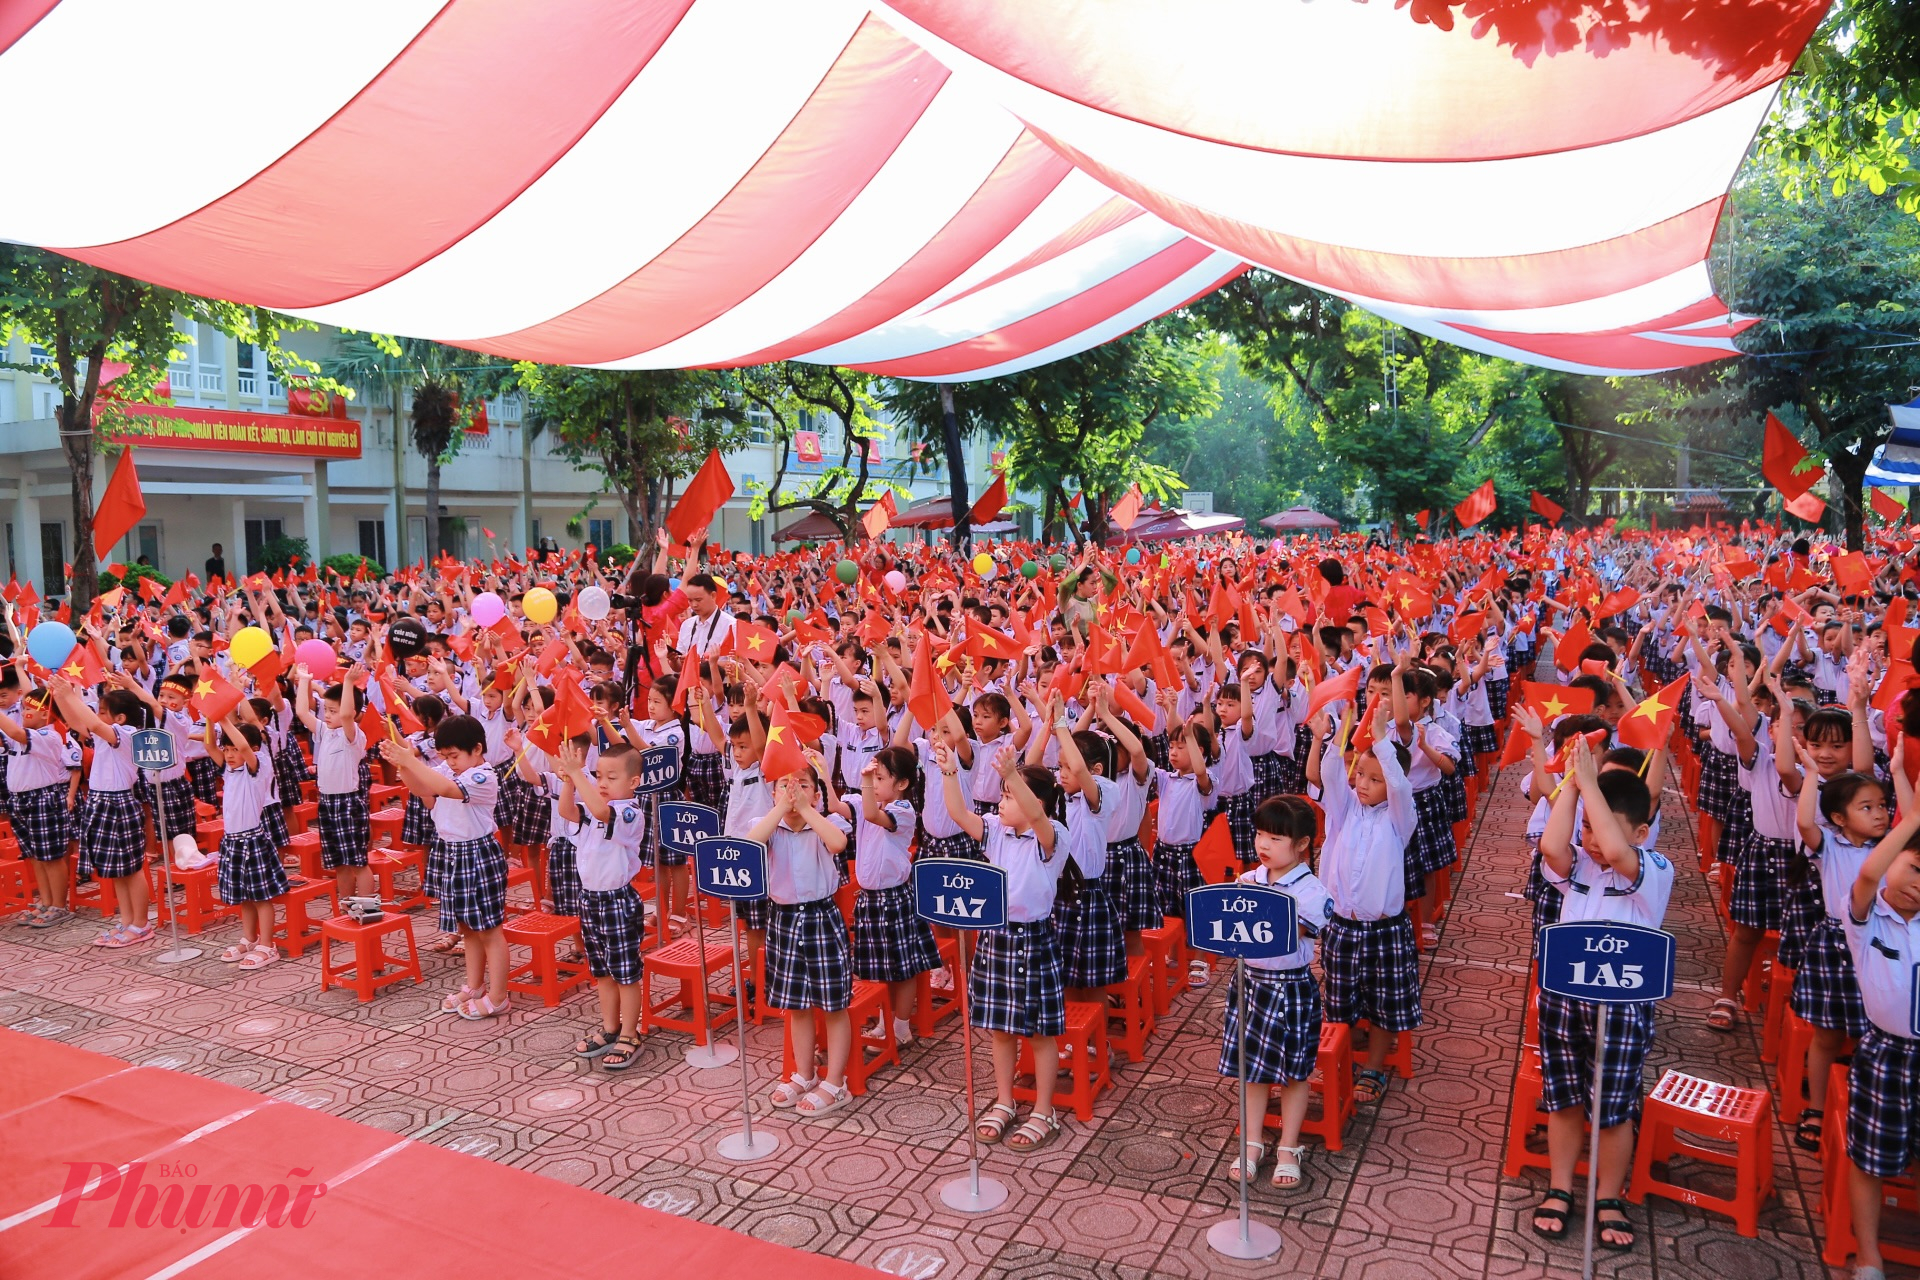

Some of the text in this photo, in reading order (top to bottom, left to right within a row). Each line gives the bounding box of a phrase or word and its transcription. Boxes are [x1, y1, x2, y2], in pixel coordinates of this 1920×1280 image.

[212, 420, 229, 440] VIÊN
[229, 421, 247, 441] ĐOÀN
[261, 424, 278, 443] SÁNG
[292, 426, 305, 445] LÀM
[326, 430, 349, 448] NGUYÊN
[349, 429, 358, 448] SỐ
[144, 734, 159, 745] LỚP
[137, 749, 170, 762] 1A12
[645, 754, 664, 766] LỚP
[639, 765, 675, 787] 1A10
[676, 811, 698, 824] LỚP
[716, 846, 741, 861] LỚP
[710, 866, 751, 888] 1A8
[942, 873, 974, 890] LỚP
[932, 895, 987, 918] 1A7
[1221, 896, 1258, 913] LỚP
[1208, 919, 1274, 944] 1A6
[1584, 934, 1630, 954] LỚP
[1567, 961, 1644, 989] 1A5
